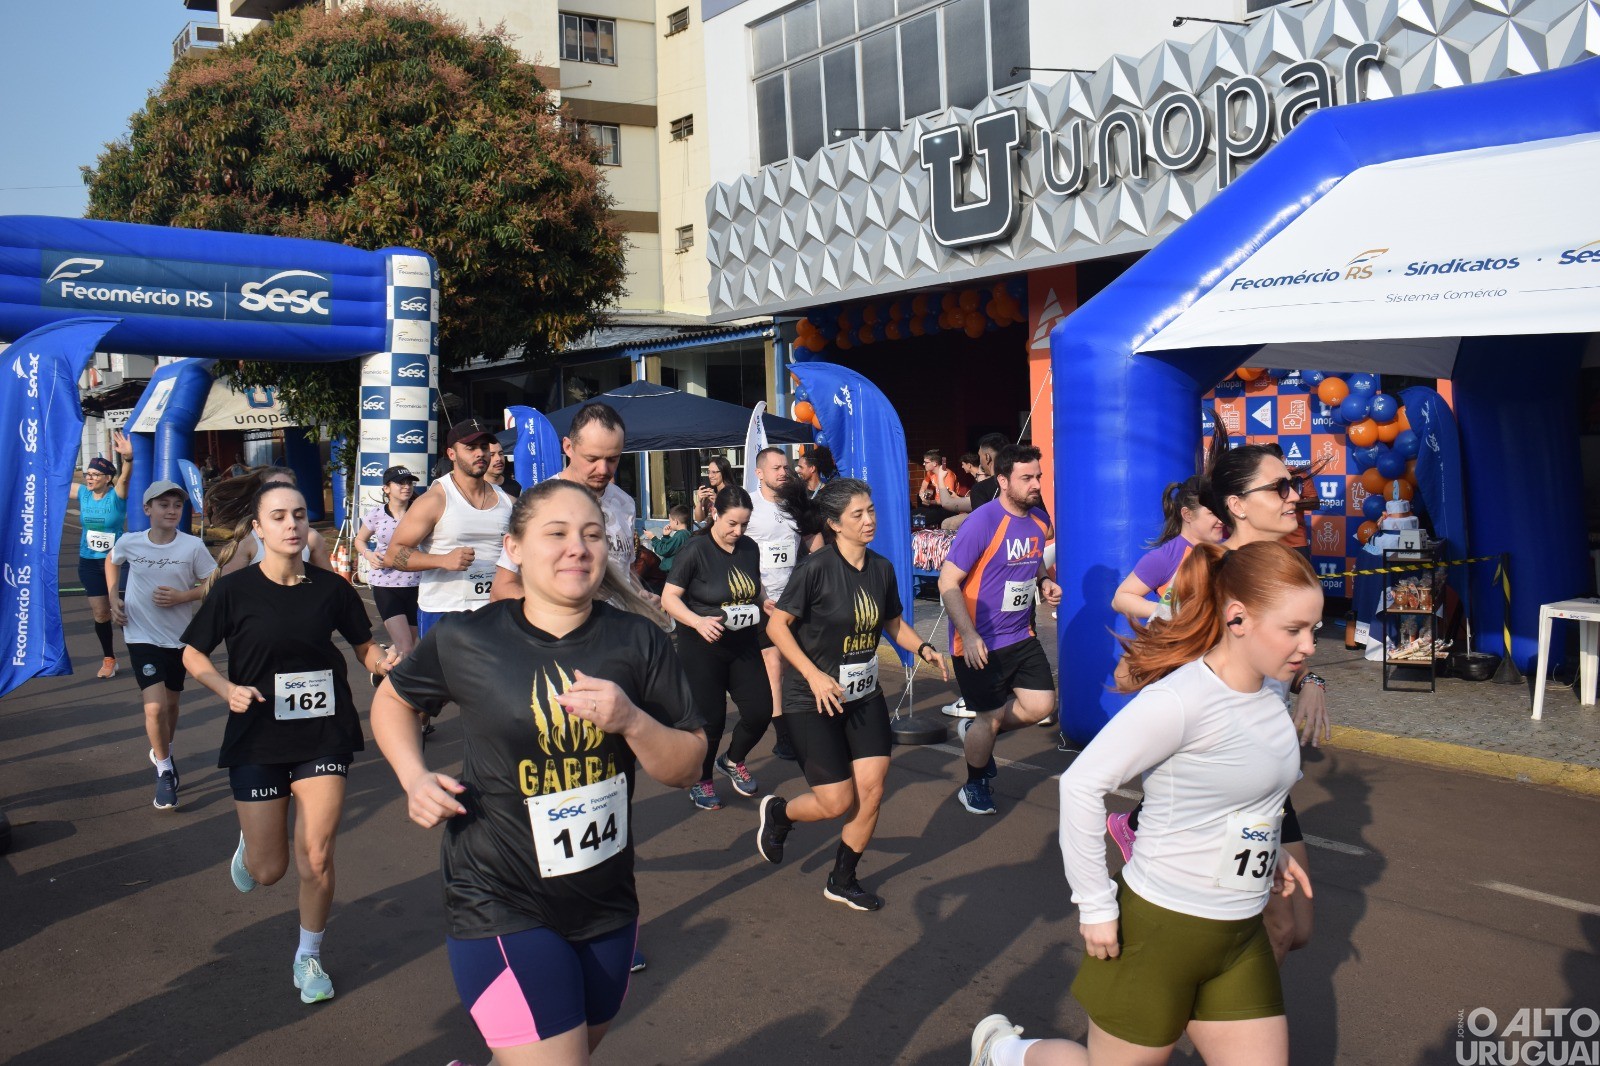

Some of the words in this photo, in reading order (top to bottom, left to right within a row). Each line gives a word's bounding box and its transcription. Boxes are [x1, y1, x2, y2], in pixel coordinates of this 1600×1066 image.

[1041, 41, 1385, 192] unopar
[1229, 270, 1340, 292] Fecomércio
[1344, 265, 1373, 281] RS
[1403, 257, 1520, 277] Sindicatos
[1557, 249, 1600, 265] Ses
[61, 281, 180, 306] Fecomércio
[185, 291, 213, 308] RS
[238, 280, 330, 316] Sesc
[1385, 292, 1440, 303] Sistema
[1443, 288, 1508, 300] Comércio
[400, 300, 428, 312] Sesc
[28, 352, 40, 399] Senac
[398, 367, 426, 378] Sesc
[362, 401, 386, 411] Sesc
[234, 412, 299, 428] unopa
[1312, 417, 1334, 427] unop
[25, 418, 38, 454] Sesc
[396, 434, 424, 444] Sesc
[1284, 459, 1311, 468] hanguera
[361, 467, 384, 477] Sesc
[20, 473, 36, 546] Sindicatos
[1319, 498, 1345, 508] nopar
[90, 540, 110, 549] 196
[772, 553, 788, 563] 79
[18, 565, 31, 586] RS
[474, 581, 493, 595] 62
[1320, 578, 1343, 589] nopar
[1012, 593, 1029, 607] 82
[732, 614, 754, 626] 171
[12, 588, 30, 667] Fecomércio
[285, 681, 307, 689] Sesc
[846, 675, 874, 695] 189
[284, 691, 327, 712] 162
[315, 763, 347, 774] MORE
[518, 753, 618, 797] GARRA
[251, 786, 278, 798] RUN
[547, 803, 587, 822] Sesc
[553, 812, 618, 859] 144
[1241, 827, 1271, 841] Sesc
